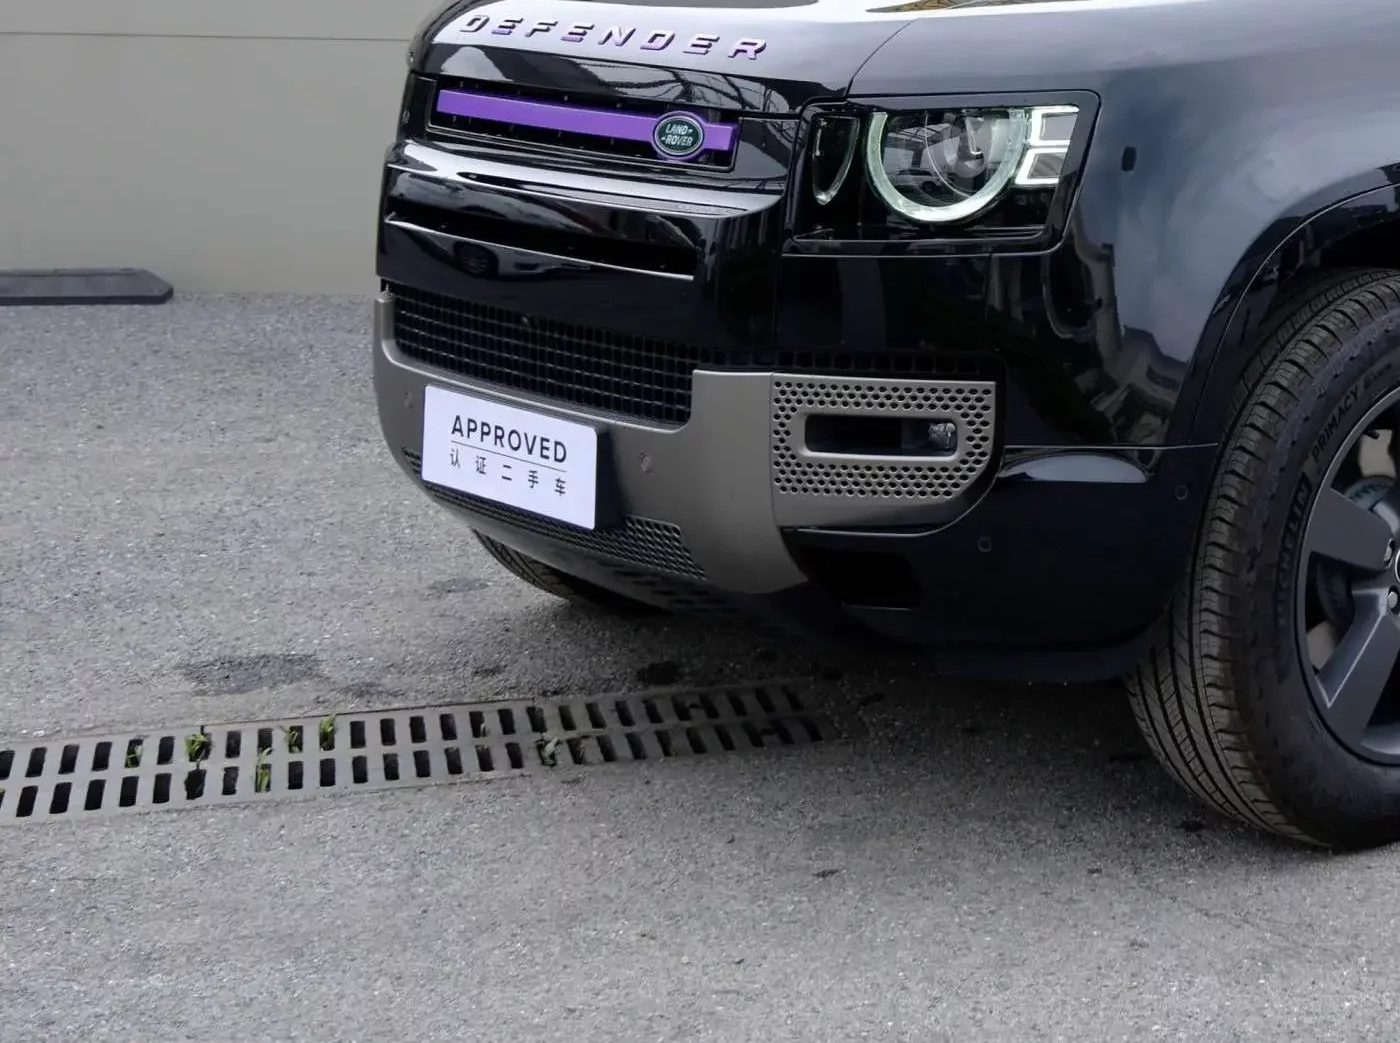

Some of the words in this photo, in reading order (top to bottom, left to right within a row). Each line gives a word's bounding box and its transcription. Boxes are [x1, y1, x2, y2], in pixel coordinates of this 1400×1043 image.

[458, 14, 768, 60] DEFENDER
[451, 414, 567, 463] APPROVED
[450, 448, 566, 497] 认证二手车
